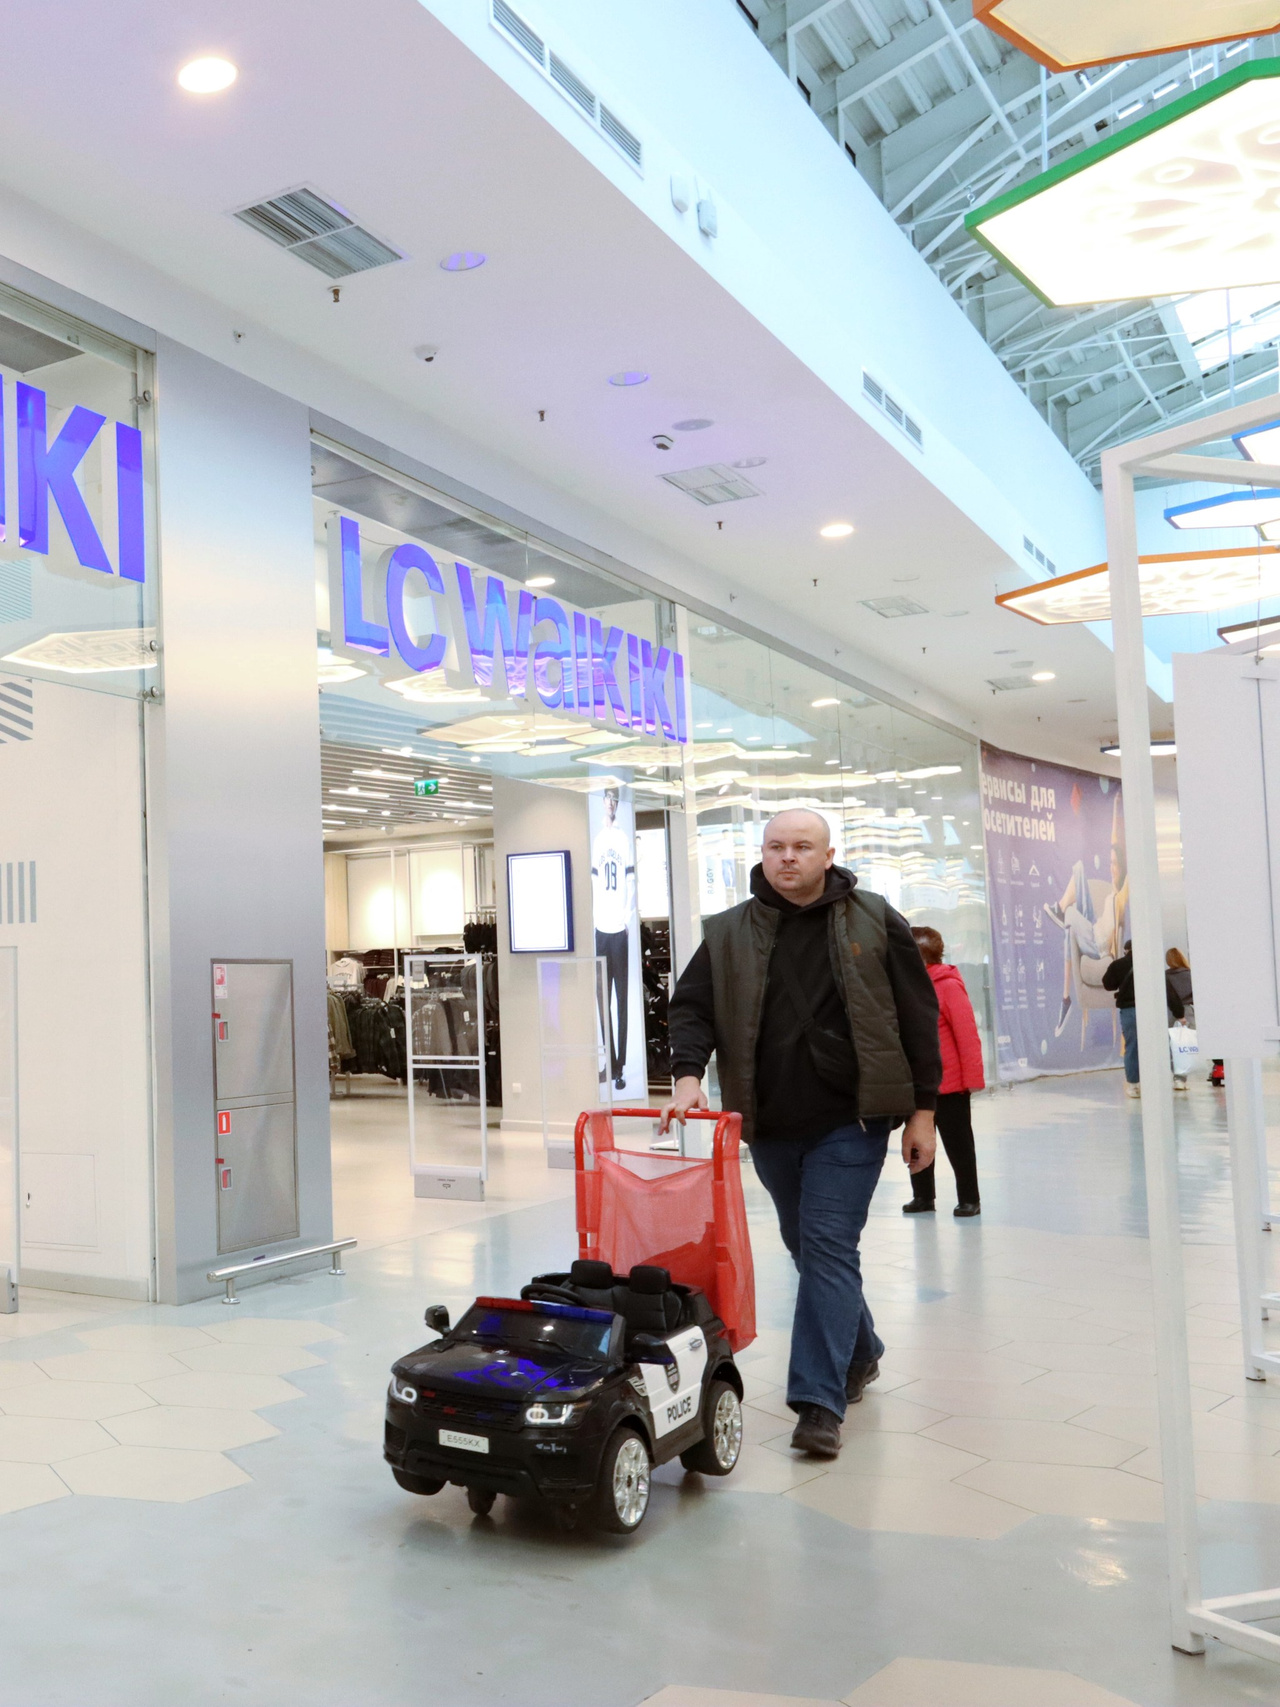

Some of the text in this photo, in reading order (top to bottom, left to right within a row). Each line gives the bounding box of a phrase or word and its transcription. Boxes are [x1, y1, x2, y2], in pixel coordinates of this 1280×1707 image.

[339, 515, 447, 674] LC
[982, 773, 1056, 813] ервисы для
[983, 807, 1056, 843] осетителей
[666, 1395, 692, 1424] POLICE
[446, 1434, 481, 1448] E555KX
